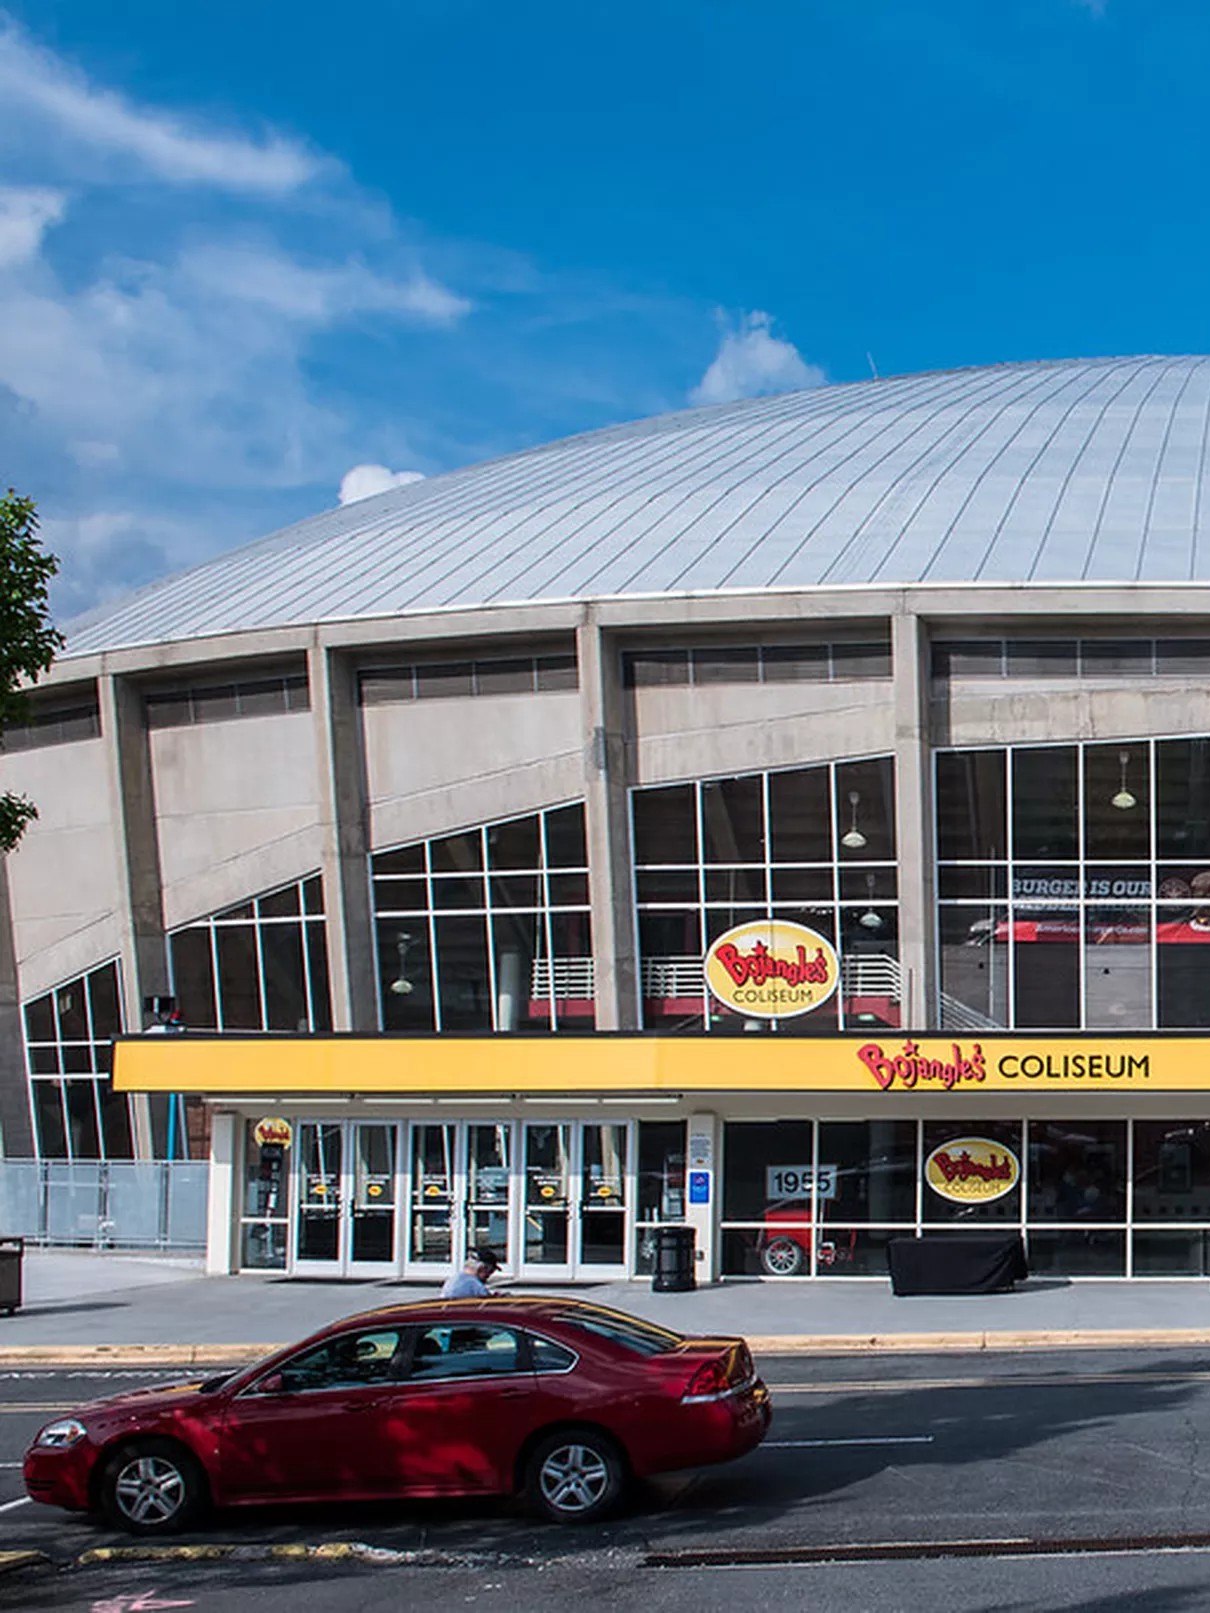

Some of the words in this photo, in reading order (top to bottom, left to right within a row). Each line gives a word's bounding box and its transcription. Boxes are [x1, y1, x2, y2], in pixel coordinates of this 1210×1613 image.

[1090, 880, 1110, 895] IS
[732, 990, 813, 1003] COLISEUM
[999, 1055, 1150, 1079] COLISEUM
[774, 1171, 831, 1193] 1955
